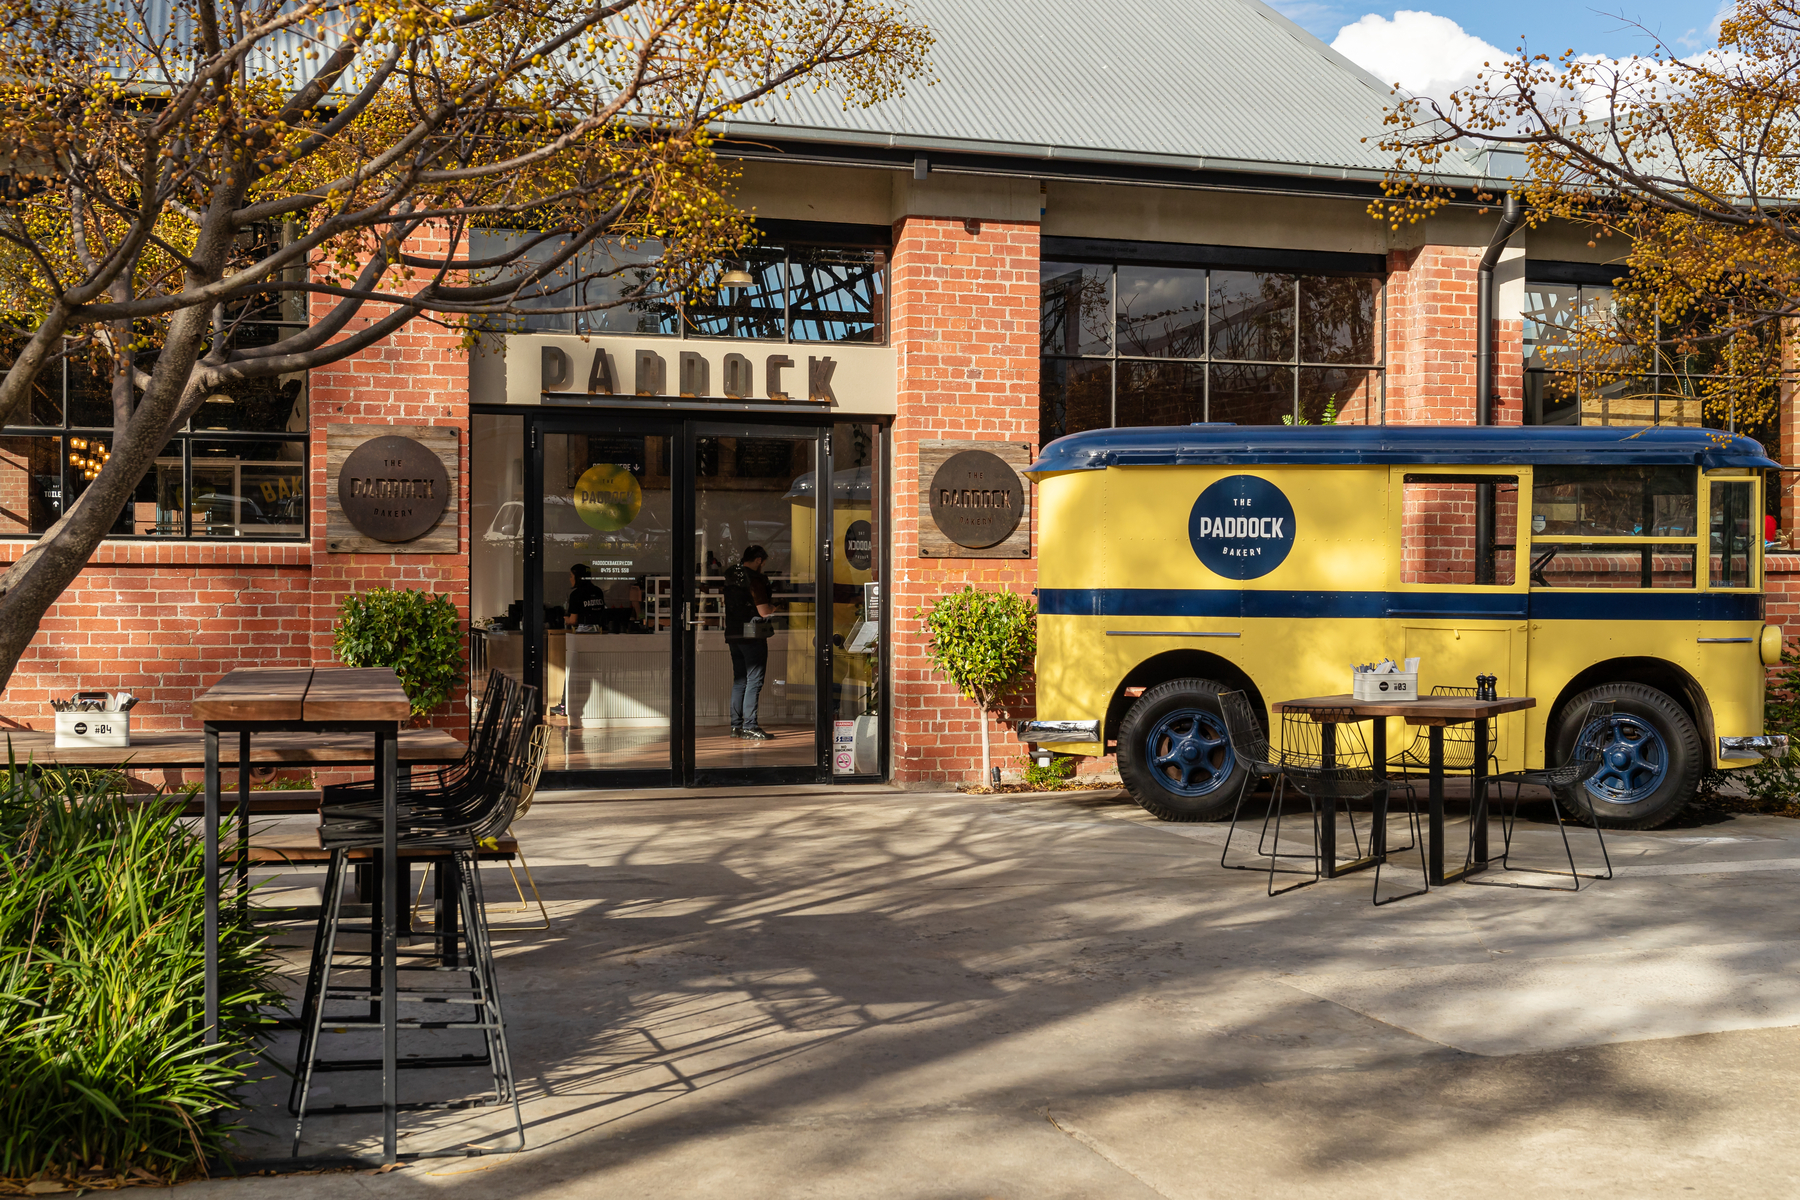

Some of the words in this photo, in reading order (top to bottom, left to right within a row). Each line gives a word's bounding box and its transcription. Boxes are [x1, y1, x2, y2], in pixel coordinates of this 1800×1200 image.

[541, 346, 832, 402] PADDOCK
[350, 477, 435, 499] PADDOCK
[581, 490, 634, 505] PADDOCK
[940, 489, 1012, 509] PADDOCK
[1233, 498, 1252, 506] THE
[373, 508, 413, 518] BAKERY
[960, 516, 993, 526] BAKERY
[1200, 517, 1284, 539] PADDOCK
[1222, 546, 1262, 557] BAKERY
[95, 724, 111, 733] #04
